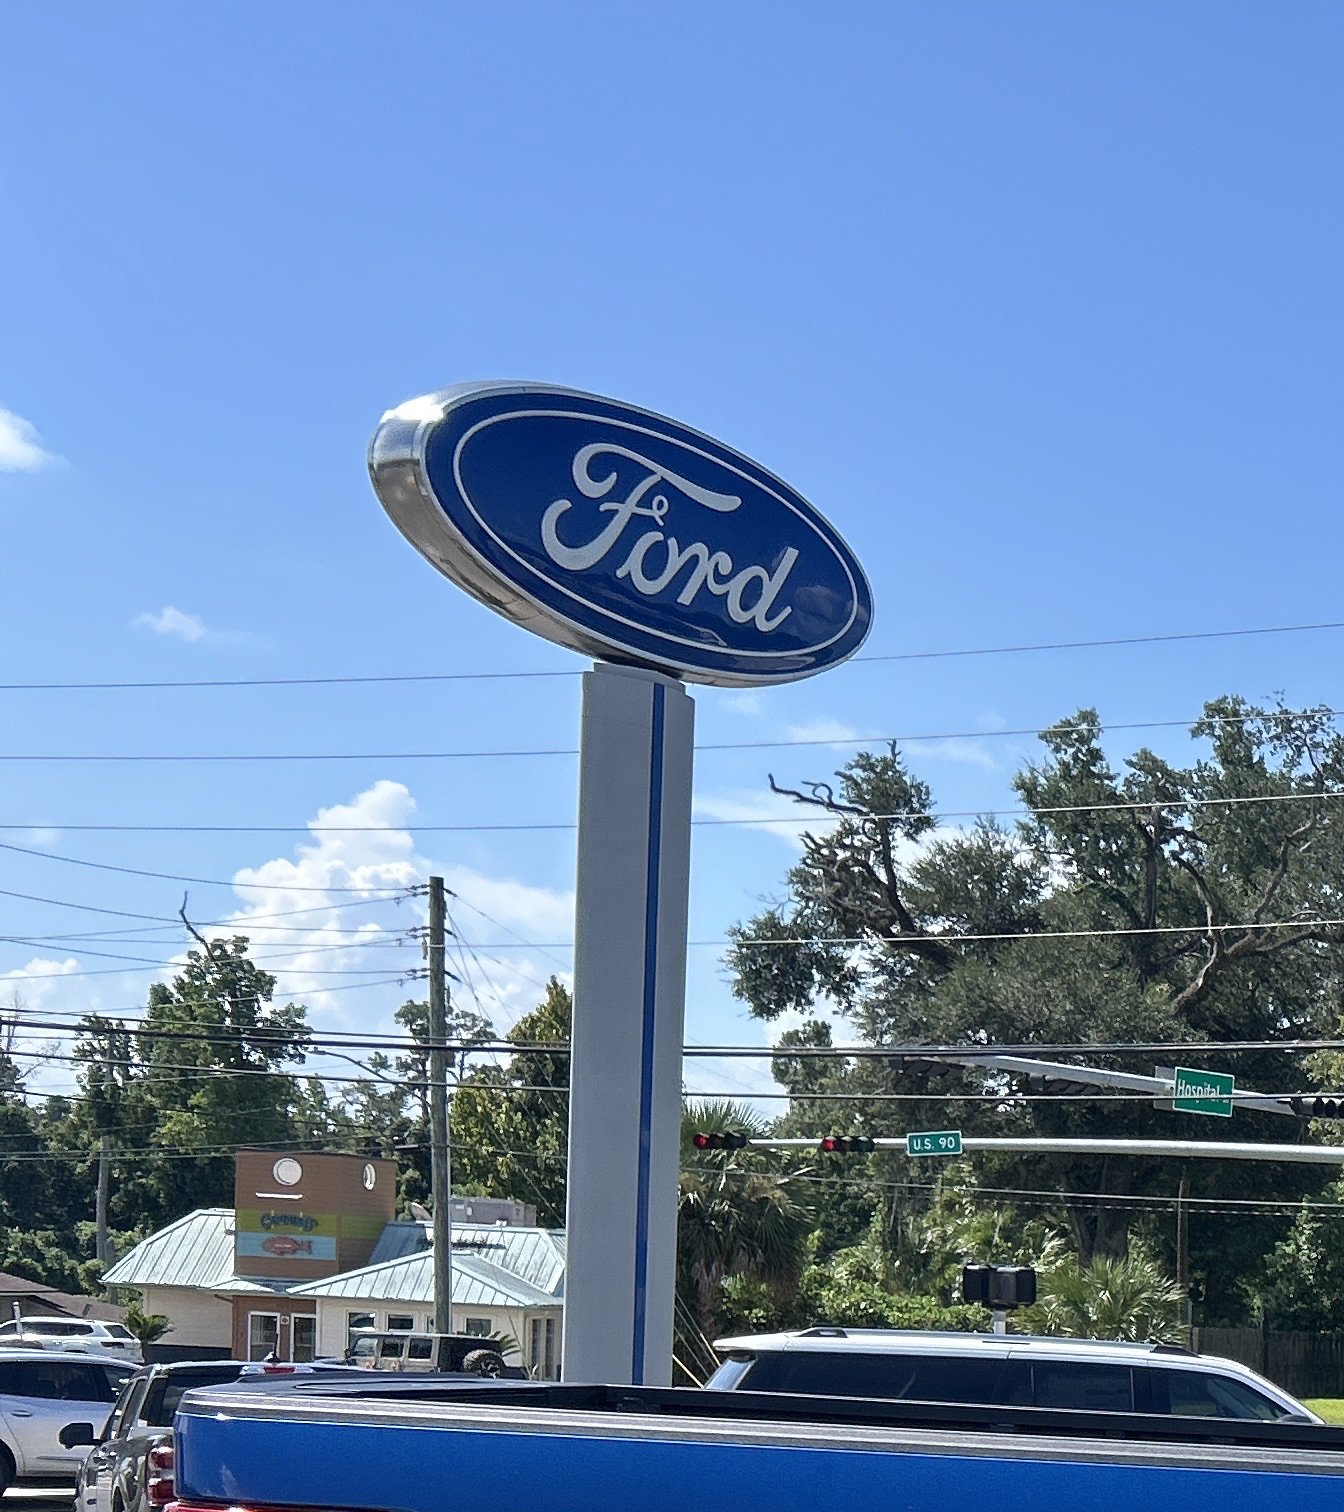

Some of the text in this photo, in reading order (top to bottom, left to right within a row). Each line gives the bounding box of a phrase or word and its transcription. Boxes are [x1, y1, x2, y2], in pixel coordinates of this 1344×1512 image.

[541, 442, 799, 634] Ford
[1177, 1079, 1220, 1104] Hospital
[914, 1137, 955, 1150] U.S. 90
